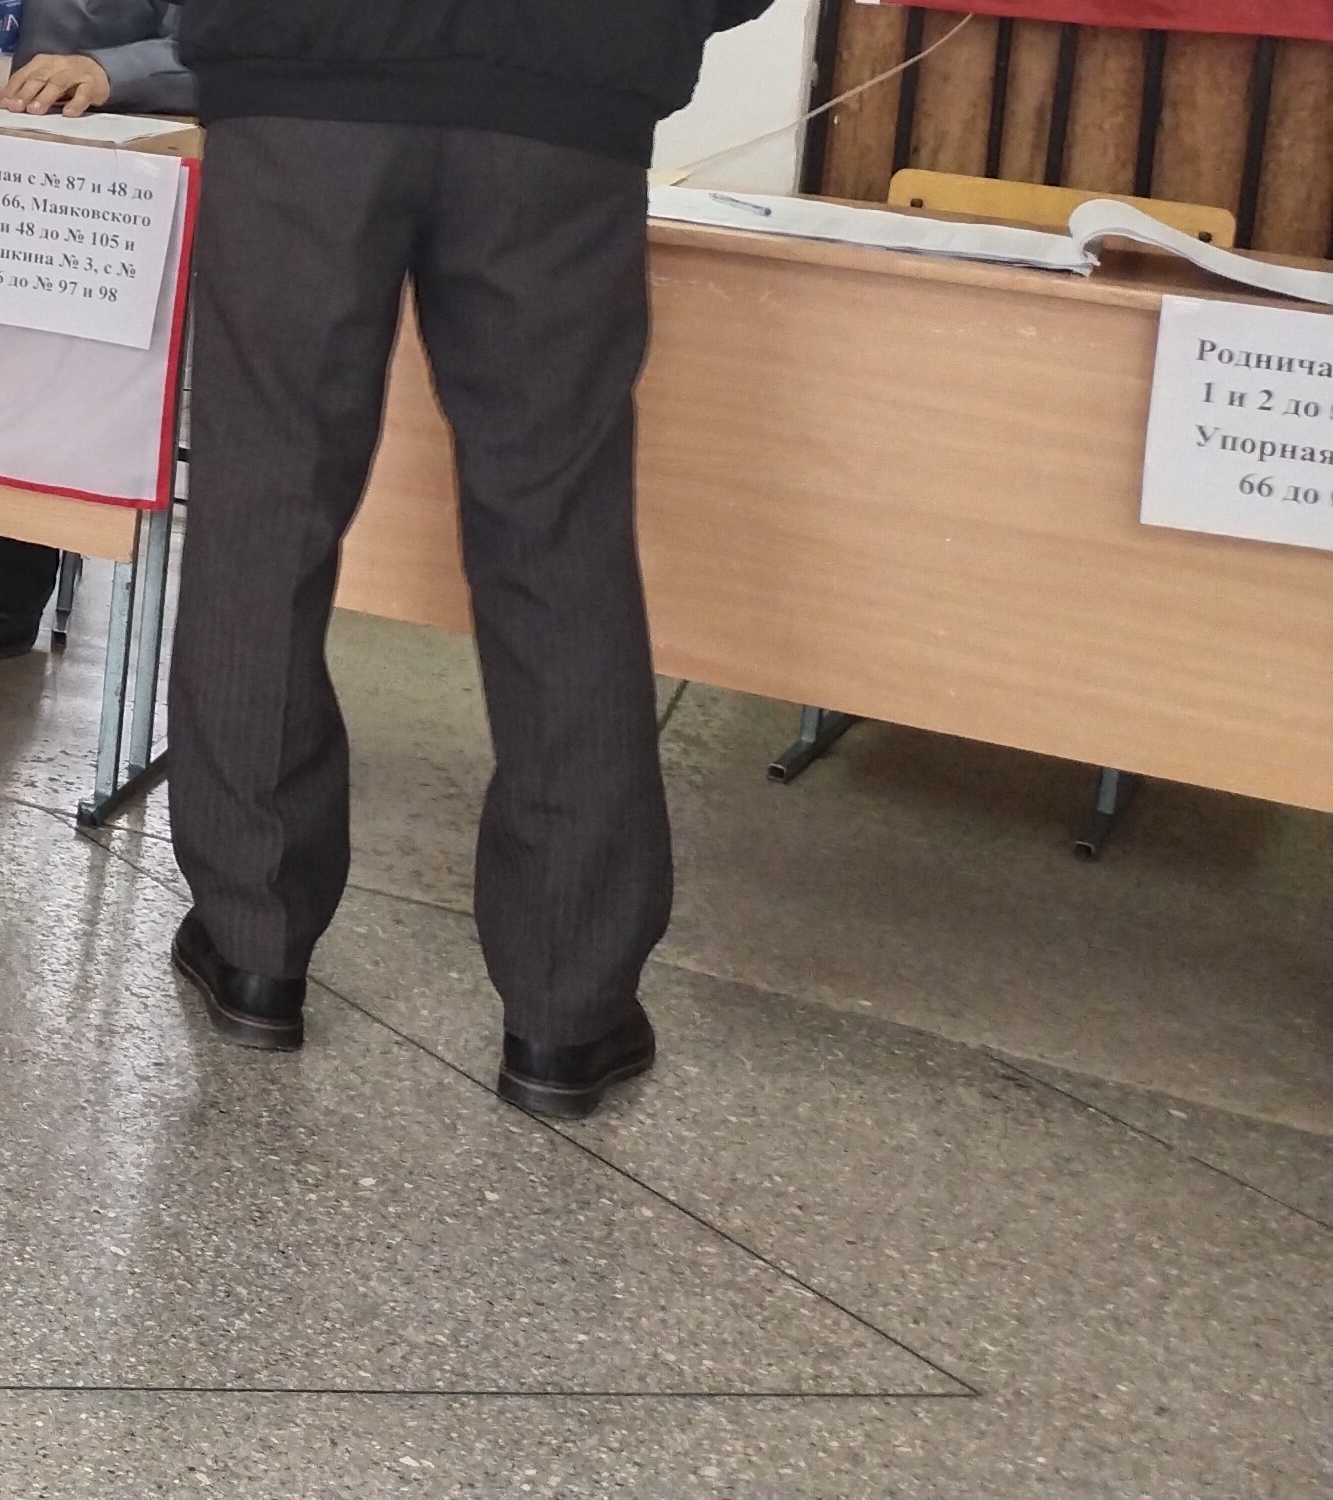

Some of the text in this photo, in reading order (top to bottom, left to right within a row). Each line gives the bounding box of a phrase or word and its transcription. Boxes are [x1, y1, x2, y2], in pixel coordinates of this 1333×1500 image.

[27, 174, 36, 185] с
[40, 172, 61, 189] №
[66, 175, 86, 192] 87
[91, 183, 102, 194] и
[107, 181, 128, 197] 48
[132, 188, 153, 202] до
[1, 193, 25, 211] 66,
[31, 197, 151, 227] Маяковского
[0, 223, 10, 234] и
[15, 221, 35, 237] 48
[39, 228, 59, 242] до
[63, 227, 84, 244] №
[90, 231, 120, 249] 105
[124, 240, 135, 251] и
[58, 253, 79, 269] №
[83, 257, 98, 275] 3,
[103, 264, 112, 275] с
[116, 261, 136, 279] №
[8, 275, 28, 288] до
[32, 275, 53, 292] №
[58, 279, 78, 296] 97
[82, 287, 93, 298] и
[99, 286, 118, 302] 98
[1195, 338, 1333, 378] Роднича
[1203, 381, 1215, 403] 1
[1227, 390, 1247, 408] и
[1257, 389, 1274, 411] 2
[1283, 399, 1320, 418] до
[1195, 424, 1333, 465] Упорная
[1238, 473, 1275, 498] 66
[1282, 485, 1319, 505] до
